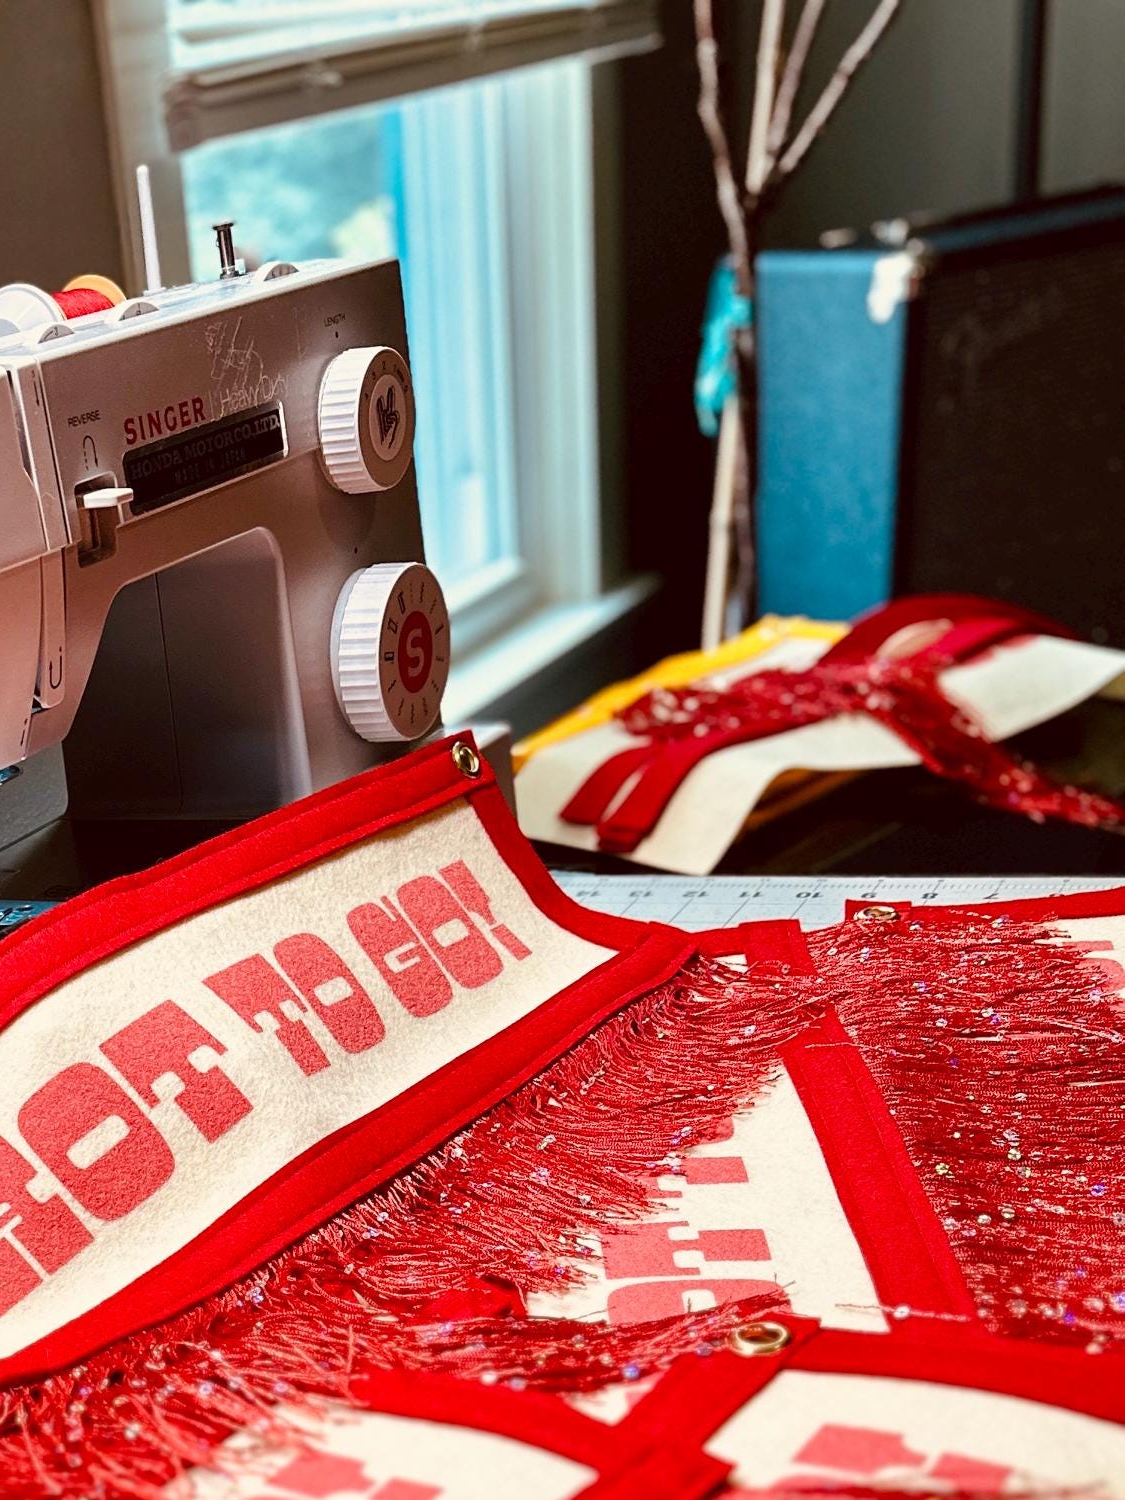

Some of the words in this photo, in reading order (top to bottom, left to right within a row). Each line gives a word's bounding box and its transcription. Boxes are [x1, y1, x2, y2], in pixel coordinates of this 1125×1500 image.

[323, 313, 346, 328] LENGTH
[67, 409, 101, 427] REVERSE
[123, 397, 206, 446] SINGER
[795, 891, 824, 899] 10
[202, 931, 387, 1078] TO
[346, 858, 533, 1020] GO!
